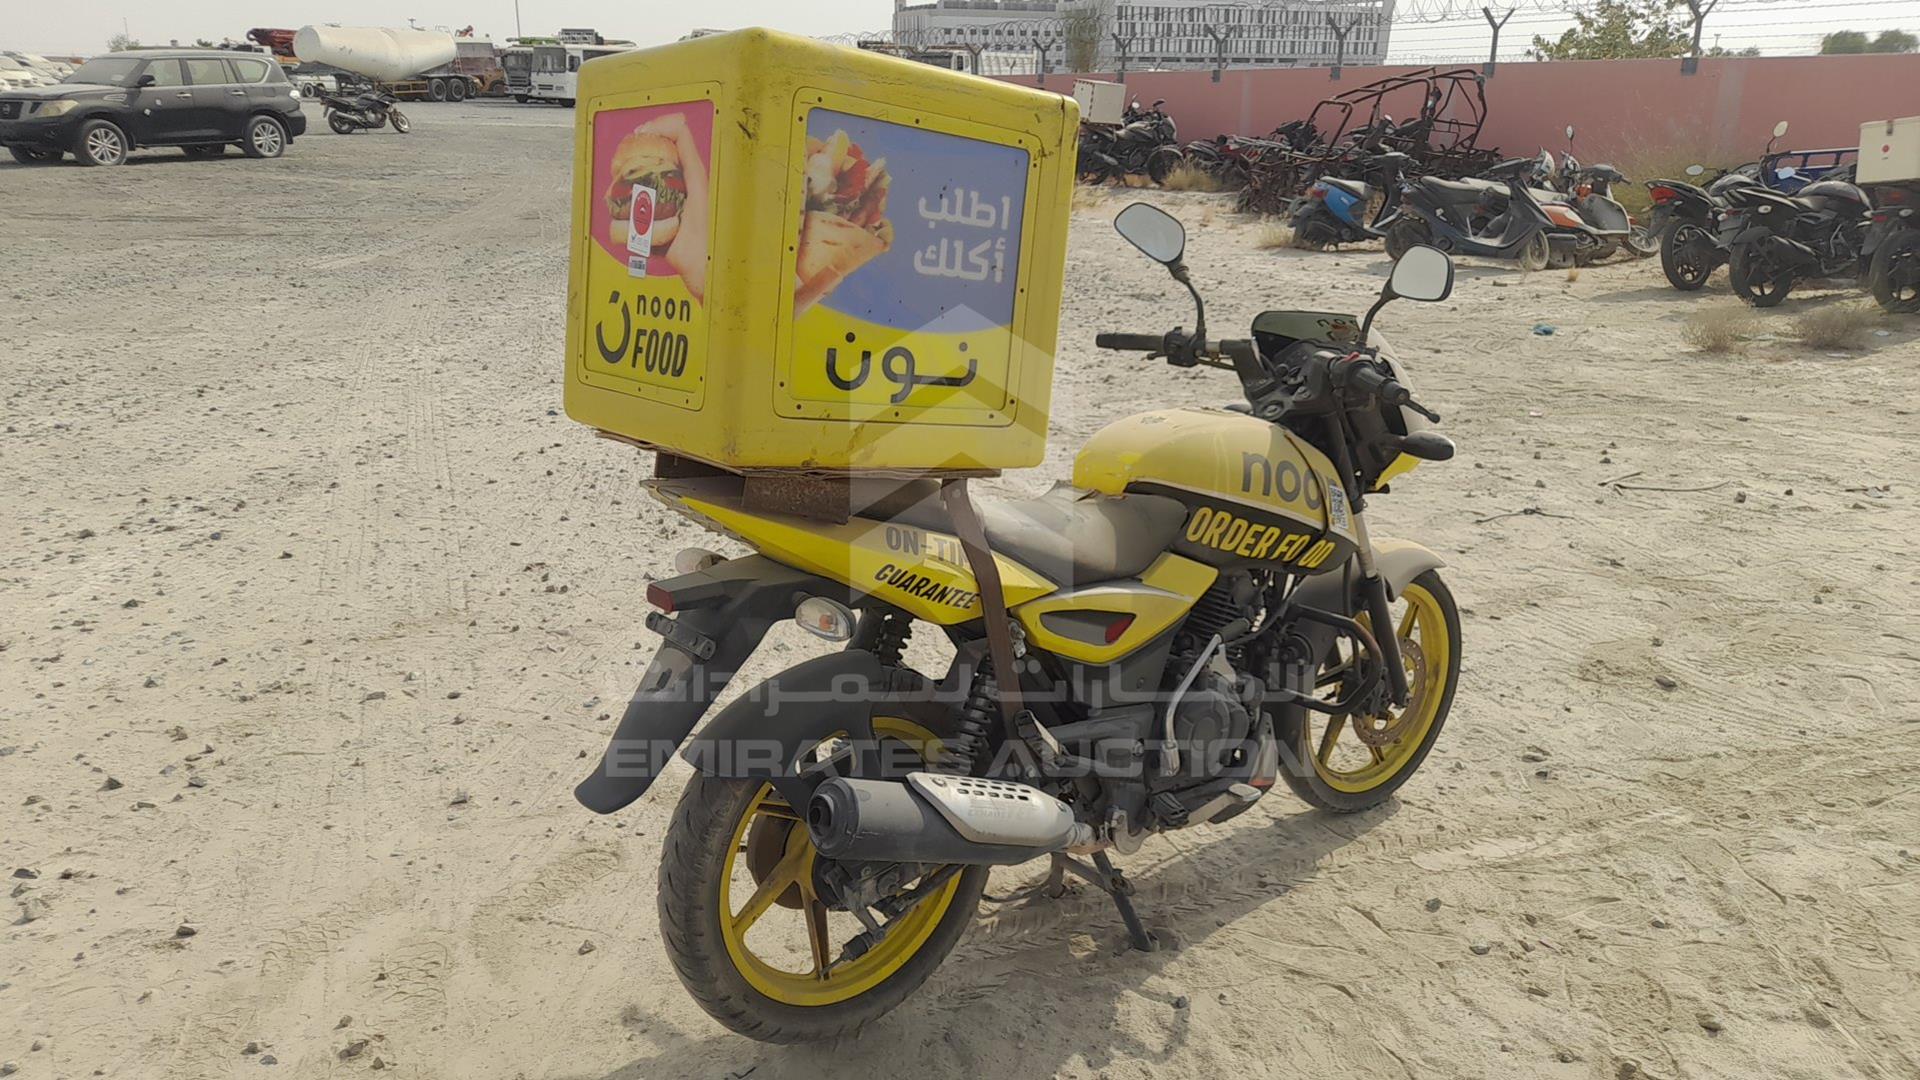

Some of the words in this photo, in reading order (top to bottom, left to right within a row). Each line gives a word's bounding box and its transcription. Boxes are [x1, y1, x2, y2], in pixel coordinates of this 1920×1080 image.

[918, 187, 1011, 231] اطلب
[913, 237, 1006, 284] أكلك
[636, 294, 690, 323] noon
[631, 328, 689, 378] FOOD
[826, 331, 978, 405] نون
[1186, 506, 1281, 559] ORDER
[874, 563, 981, 609] GUARANTEE
